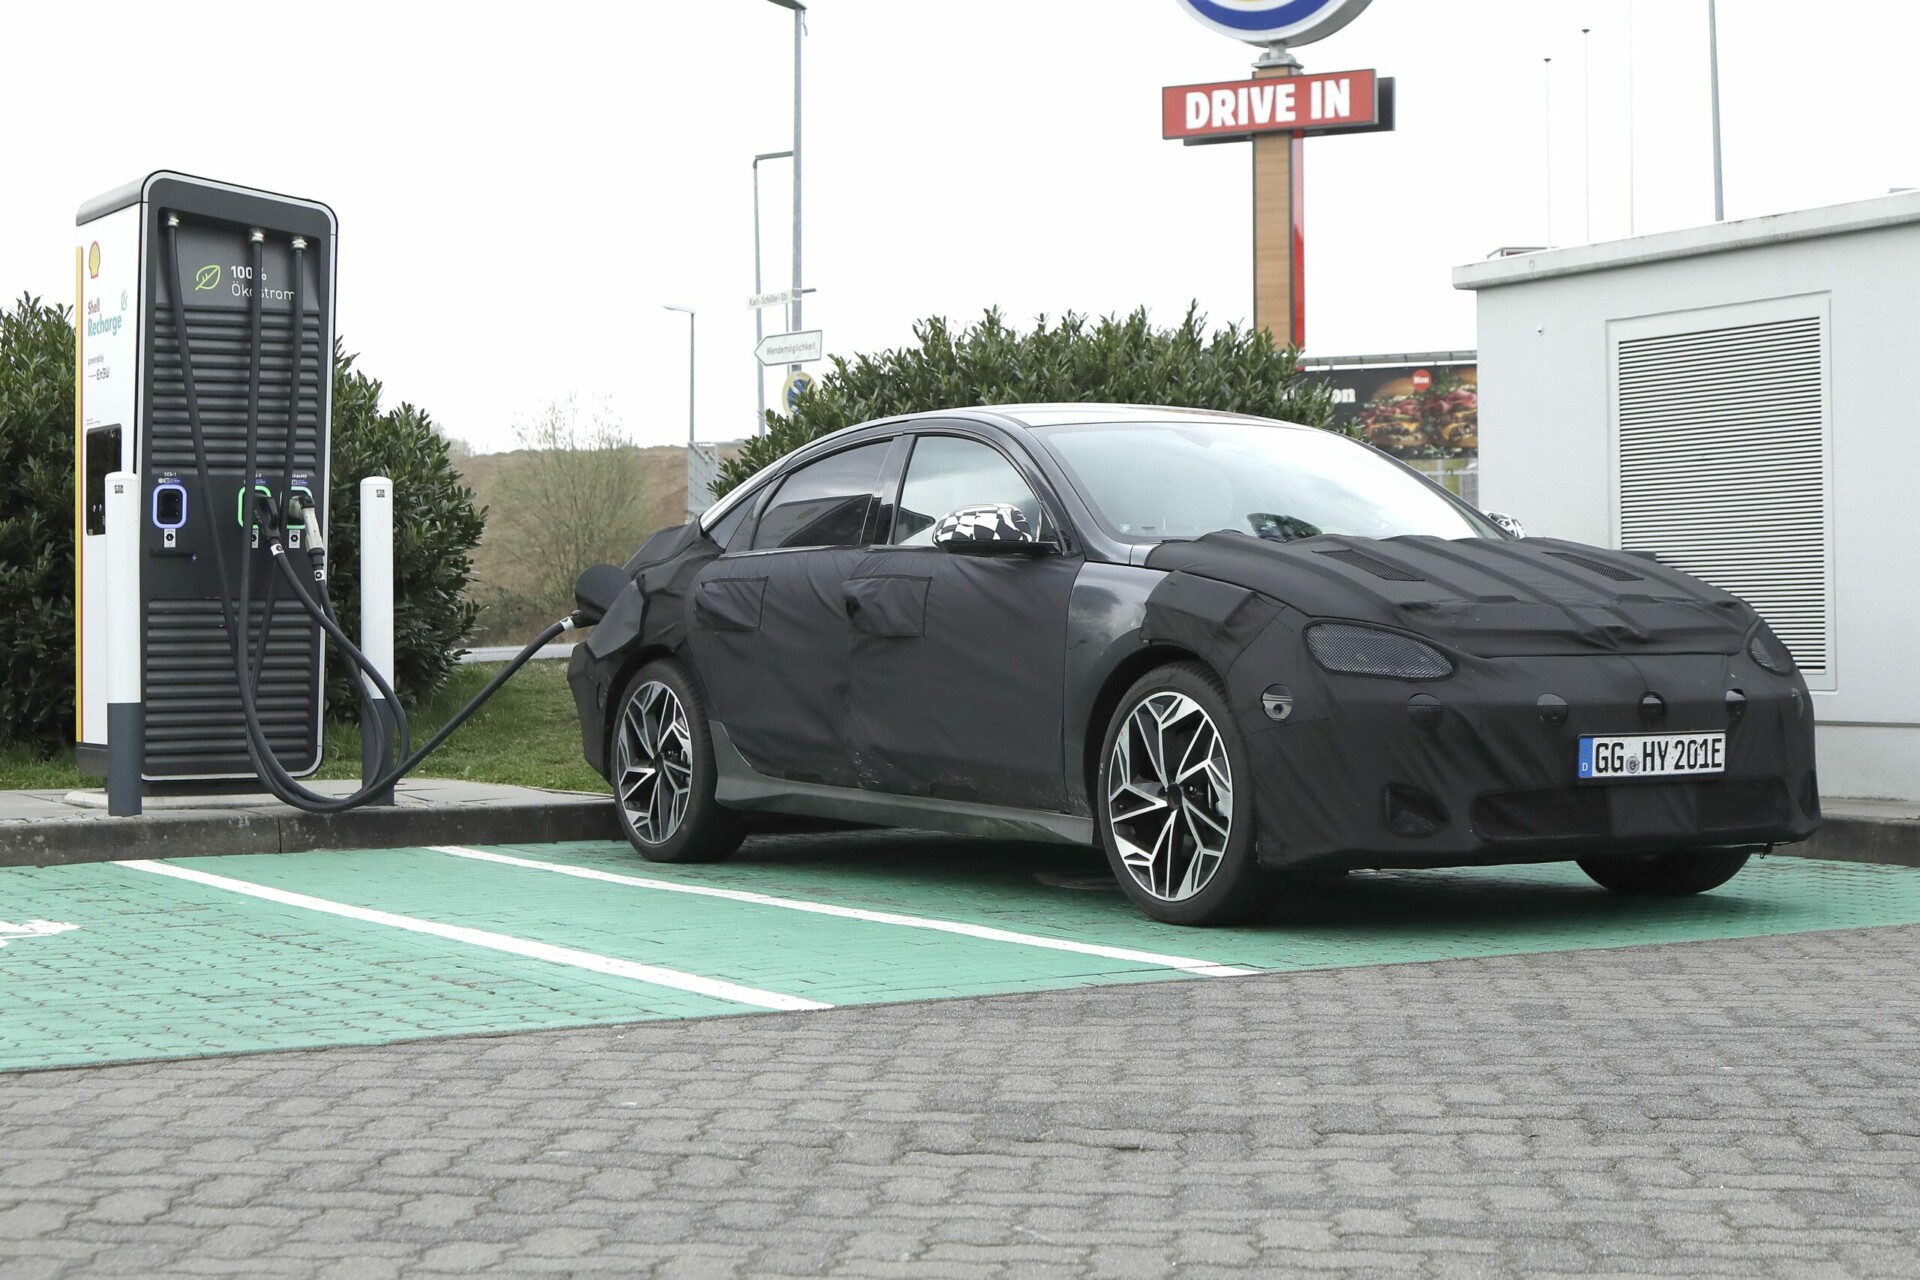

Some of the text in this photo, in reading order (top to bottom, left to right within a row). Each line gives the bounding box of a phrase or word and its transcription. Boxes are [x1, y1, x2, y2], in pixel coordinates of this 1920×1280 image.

[1185, 78, 1350, 130] DRIVE IN
[88, 297, 100, 315] Shell
[88, 313, 122, 337] Recharge
[766, 342, 816, 355] Wendemöglichkeit
[1595, 738, 1723, 773] GG HY 201E
[1582, 762, 1589, 772] D
